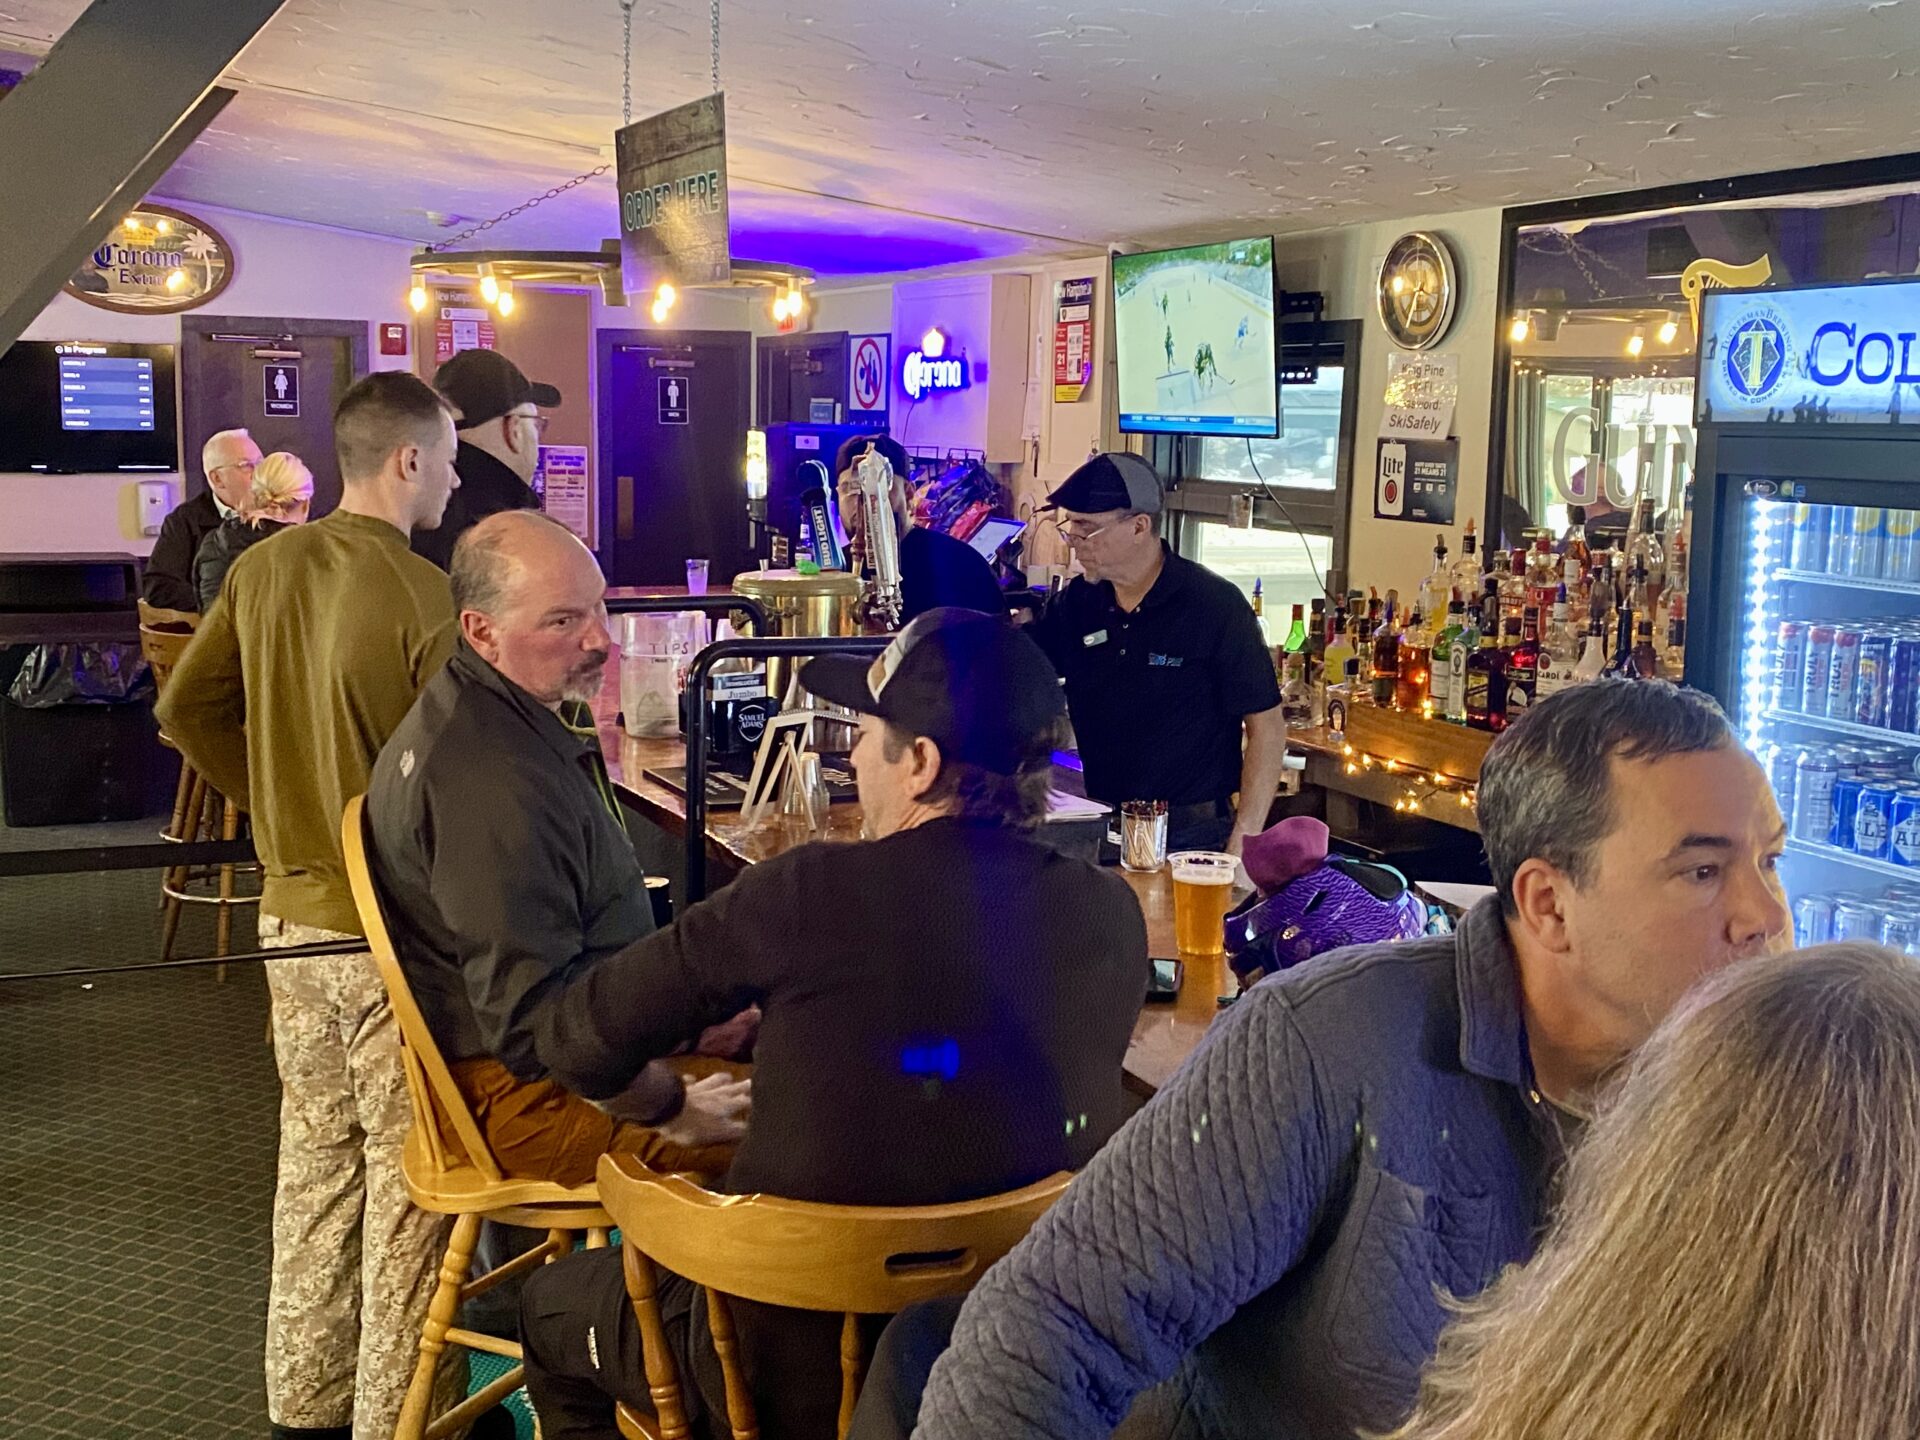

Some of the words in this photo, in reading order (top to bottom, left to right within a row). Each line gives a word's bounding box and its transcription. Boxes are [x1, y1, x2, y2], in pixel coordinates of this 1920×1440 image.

[624, 183, 673, 231] ORDER
[675, 170, 721, 217] HERE
[92, 242, 183, 269] Corona
[438, 341, 450, 352] 21
[903, 351, 961, 399] Corona
[1424, 364, 1445, 377] Pine
[1388, 414, 1441, 434] SkiSafely
[1382, 456, 1404, 478] Lite
[813, 508, 828, 541] LIGHT
[820, 541, 832, 568] BUD
[649, 642, 689, 655] TIPS
[1805, 652, 1818, 693] TRULY
[1830, 654, 1843, 698] TRULY
[728, 690, 758, 699] Jumbo
[738, 713, 767, 723] SAMUEL
[740, 721, 764, 729] ADAMS
[1857, 822, 1888, 840] LE
